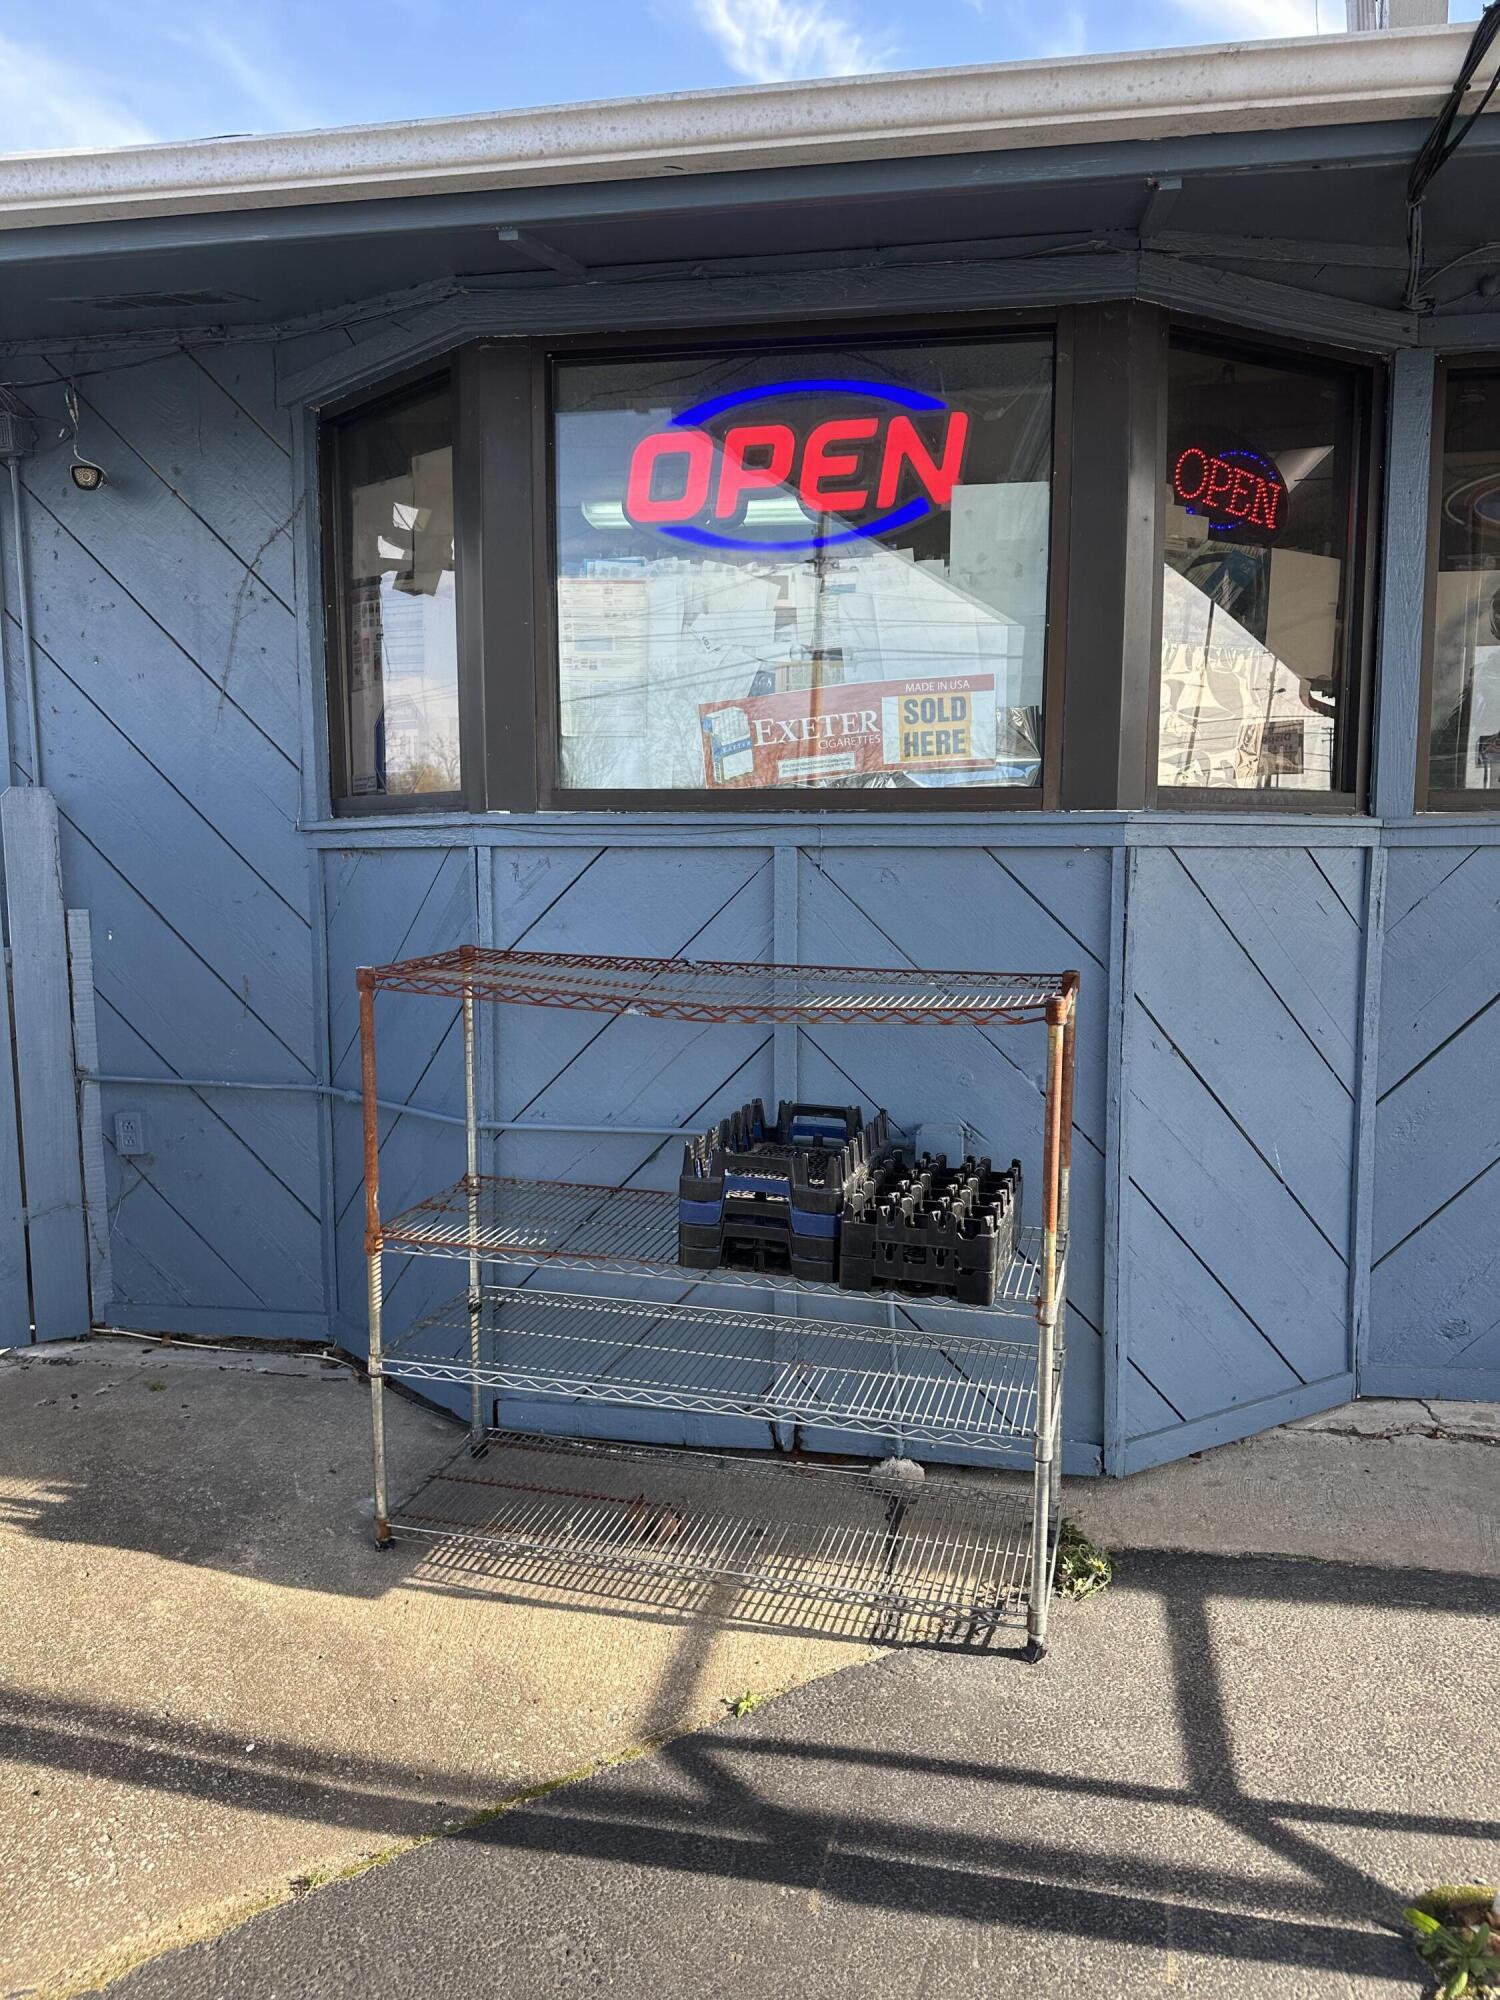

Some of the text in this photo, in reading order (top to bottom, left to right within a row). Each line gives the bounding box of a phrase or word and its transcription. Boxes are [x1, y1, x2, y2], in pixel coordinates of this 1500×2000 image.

[627, 411, 969, 523] OPEN
[1175, 448, 1281, 529] OPEN
[905, 679, 970, 692] MADE IN USA
[903, 696, 967, 724] SOLD
[752, 710, 881, 747] EXETER
[818, 734, 881, 750] CIGARETTES
[903, 729, 967, 757] HERE
